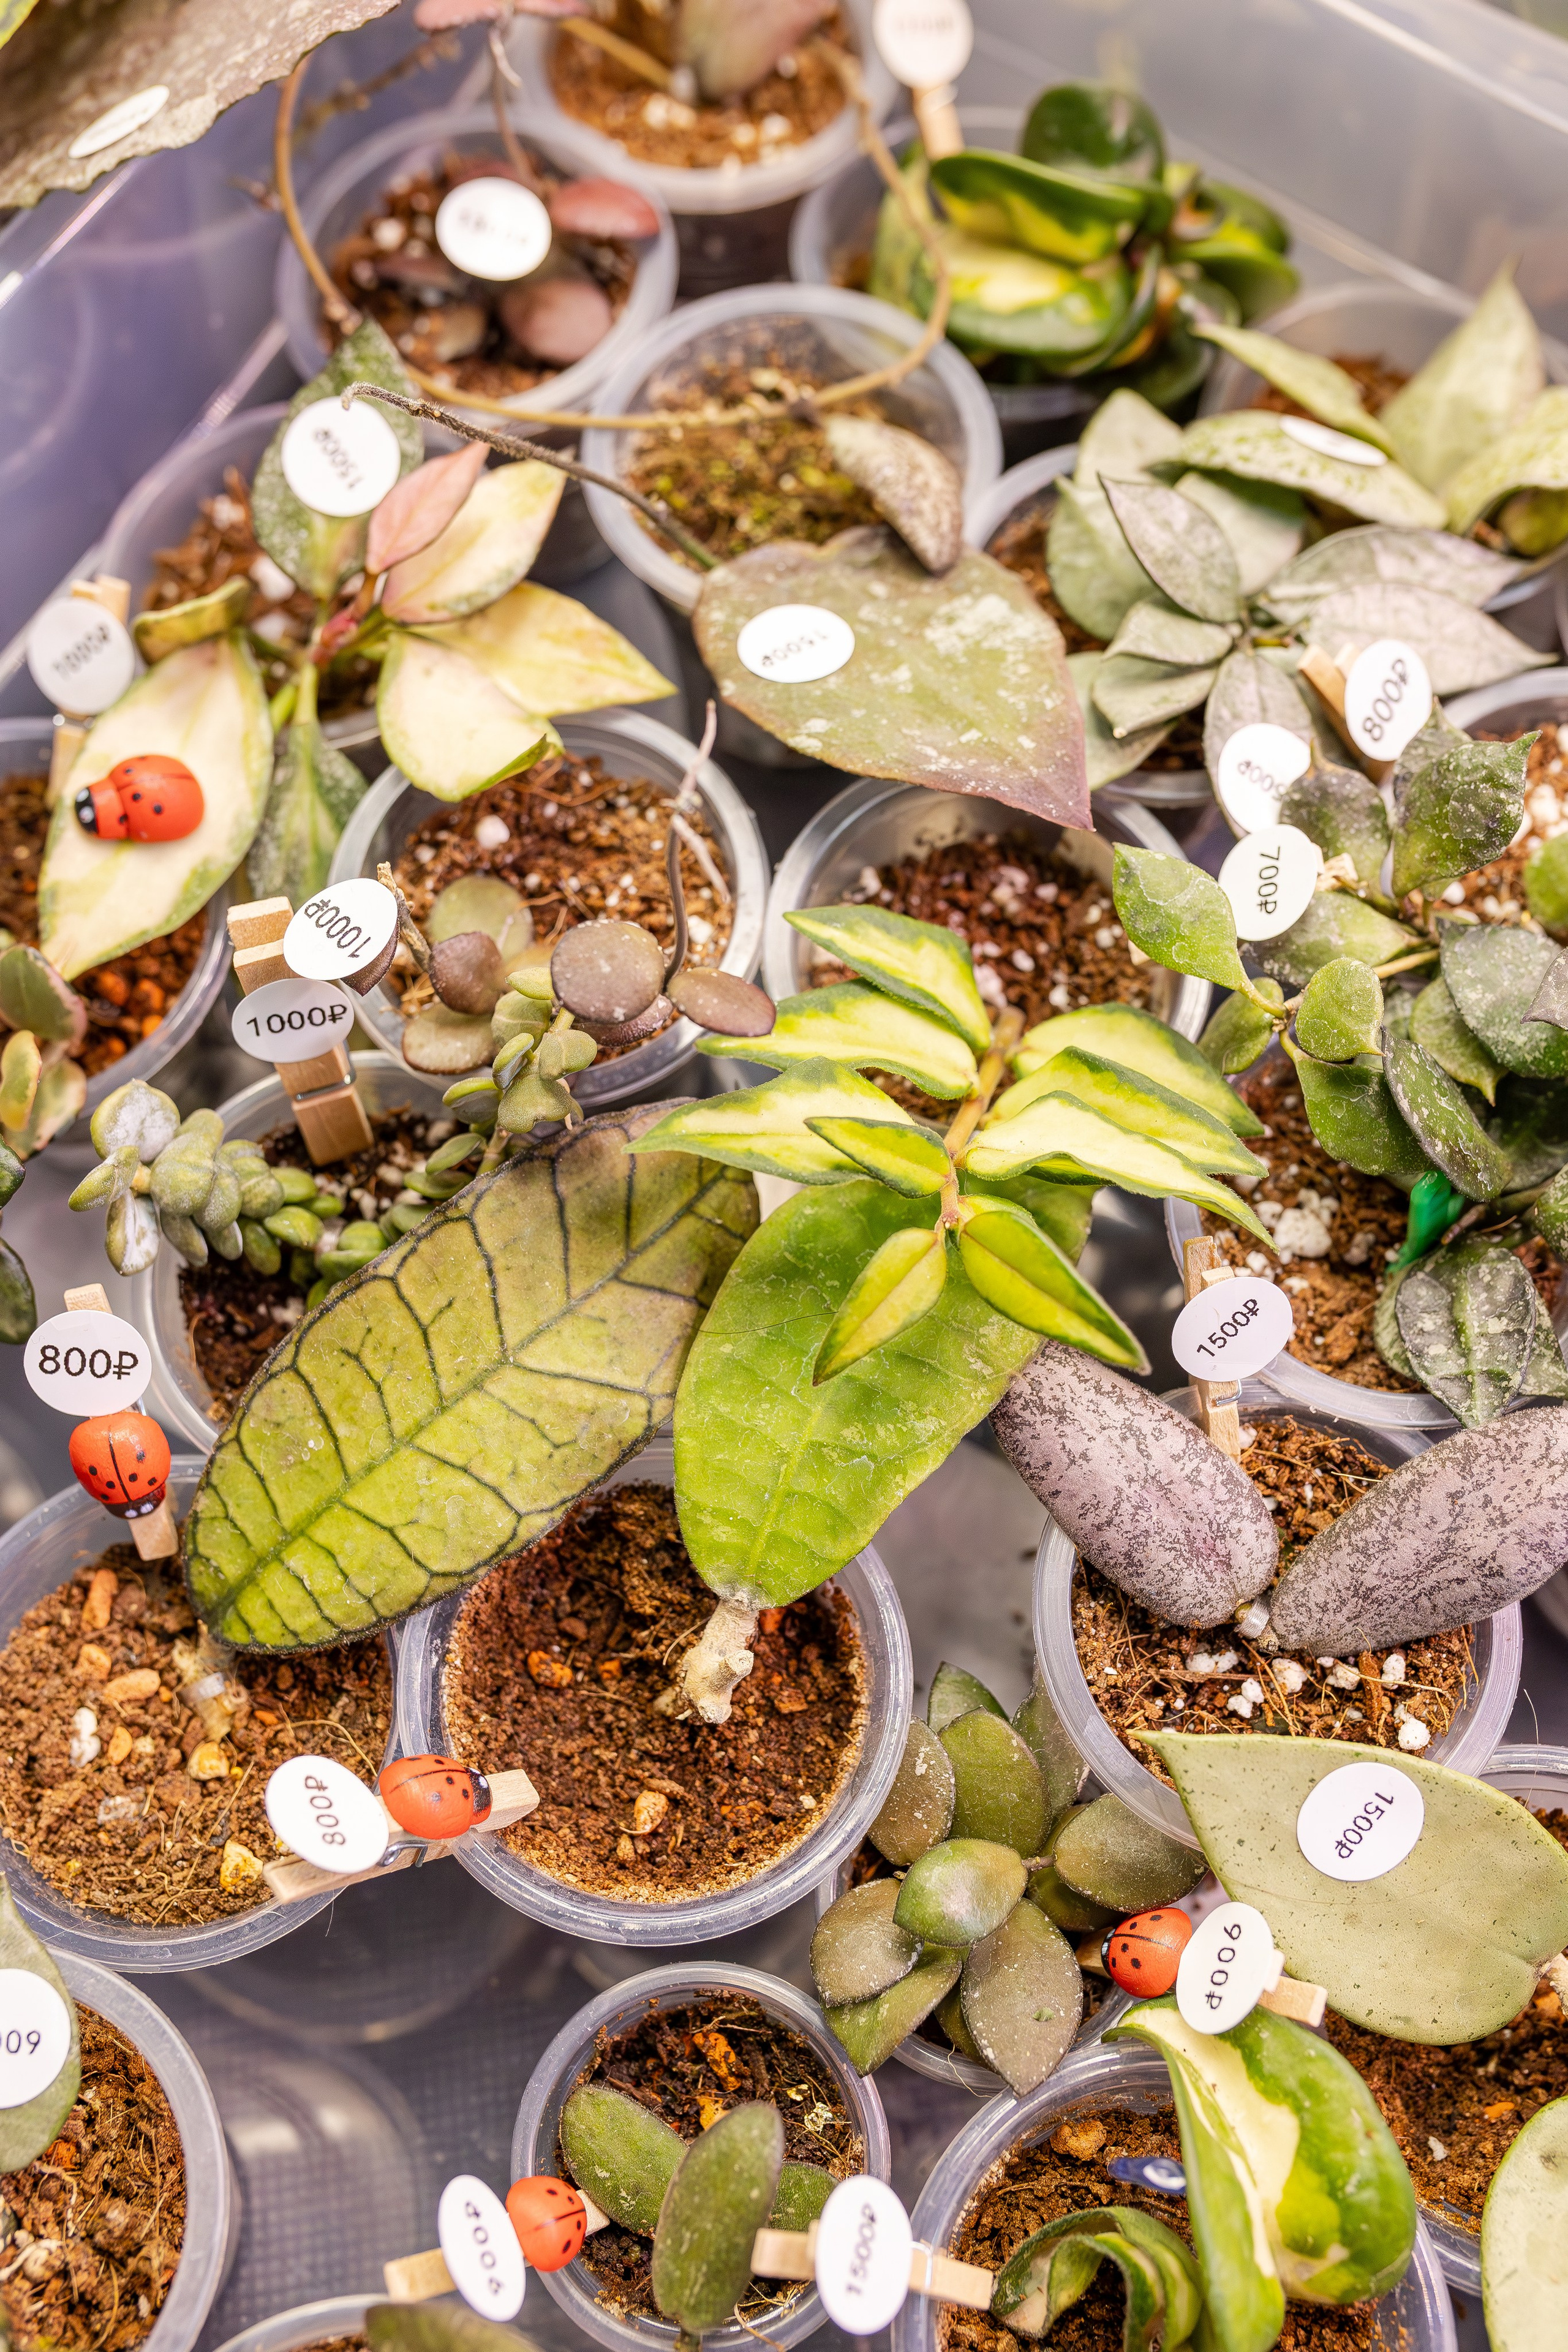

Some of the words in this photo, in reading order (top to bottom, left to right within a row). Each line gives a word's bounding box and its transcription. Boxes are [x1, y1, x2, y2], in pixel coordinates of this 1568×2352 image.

[1362, 658, 1408, 742] 800₽
[1237, 760, 1287, 802] 500₽
[1257, 846, 1281, 914] 700₽
[304, 899, 371, 959] 1000₽
[246, 1003, 348, 1036] 1000₽
[1196, 1298, 1260, 1357] 1500₽
[38, 1344, 139, 1380] 800₽
[304, 1776, 345, 1845] 800₽
[1335, 1792, 1394, 1859] 1500₽
[1205, 1924, 1242, 2010] 900₽
[846, 2204, 876, 2294] 1500₽
